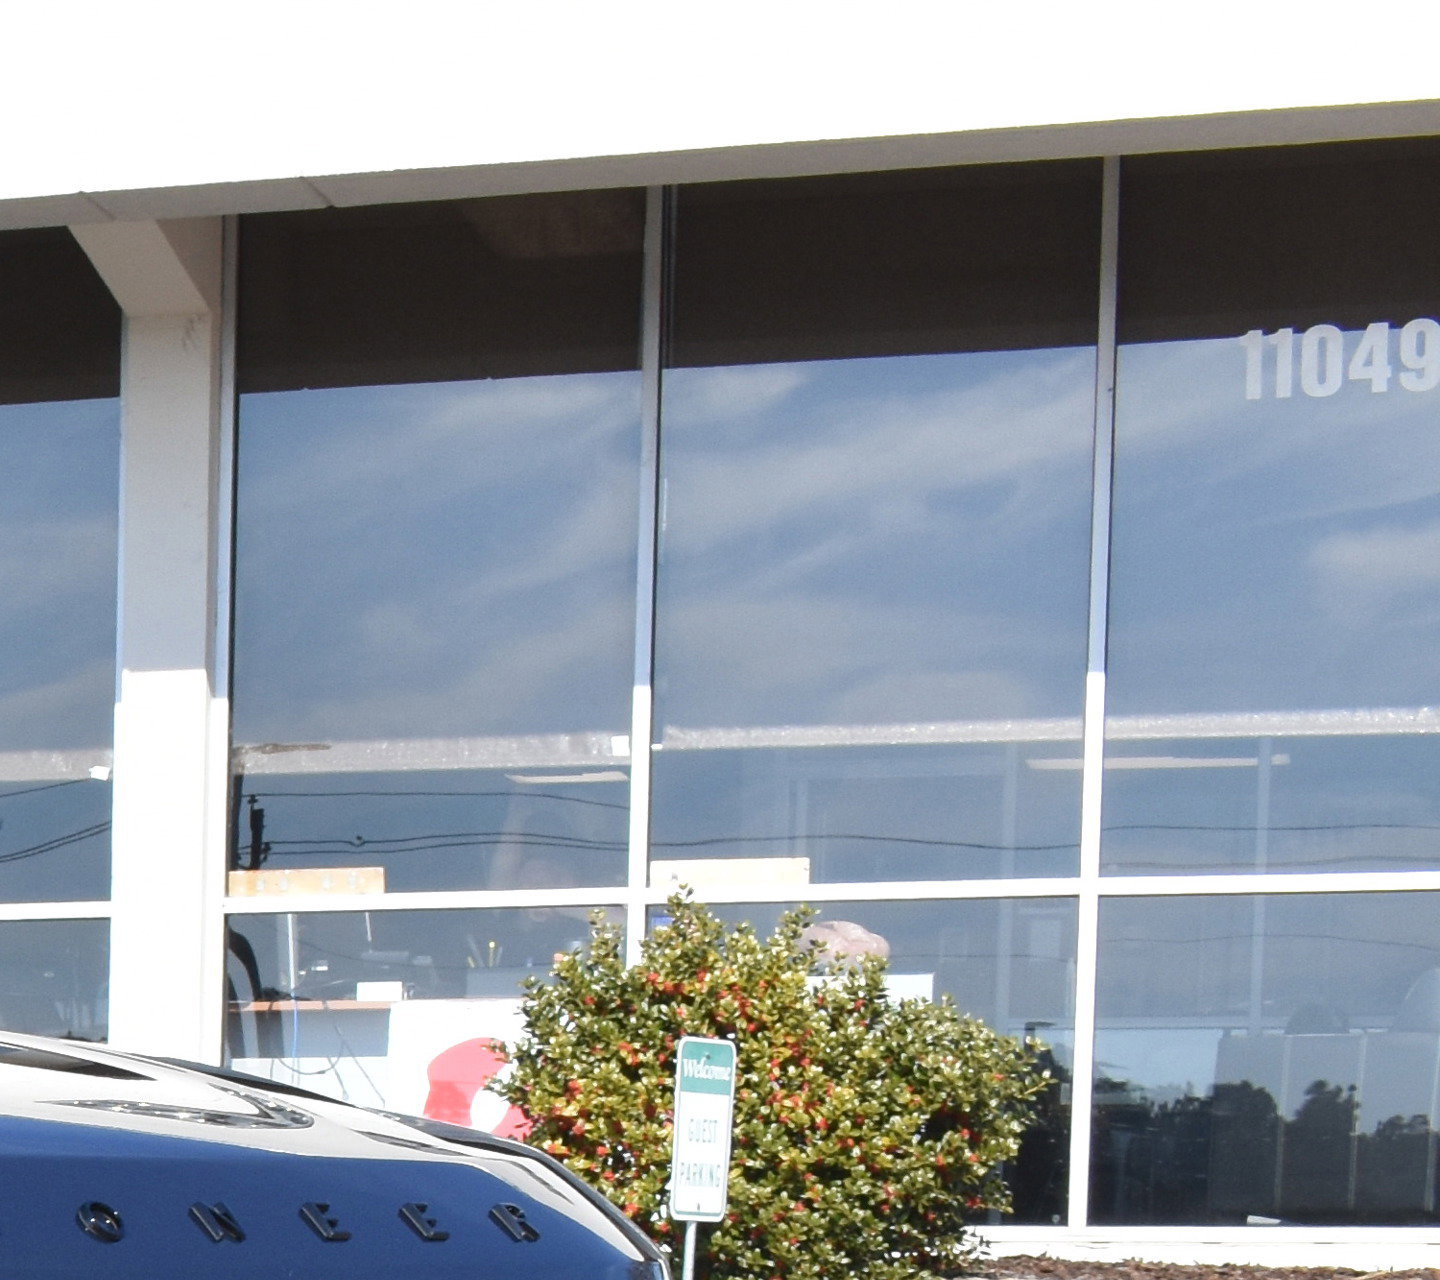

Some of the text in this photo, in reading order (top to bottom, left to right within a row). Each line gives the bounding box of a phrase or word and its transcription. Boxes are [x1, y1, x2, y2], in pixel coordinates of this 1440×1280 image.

[1238, 318, 1440, 400] 11049
[683, 1057, 731, 1082] Welcome
[688, 1118, 718, 1144] GUEST
[679, 1162, 721, 1188] PARKING
